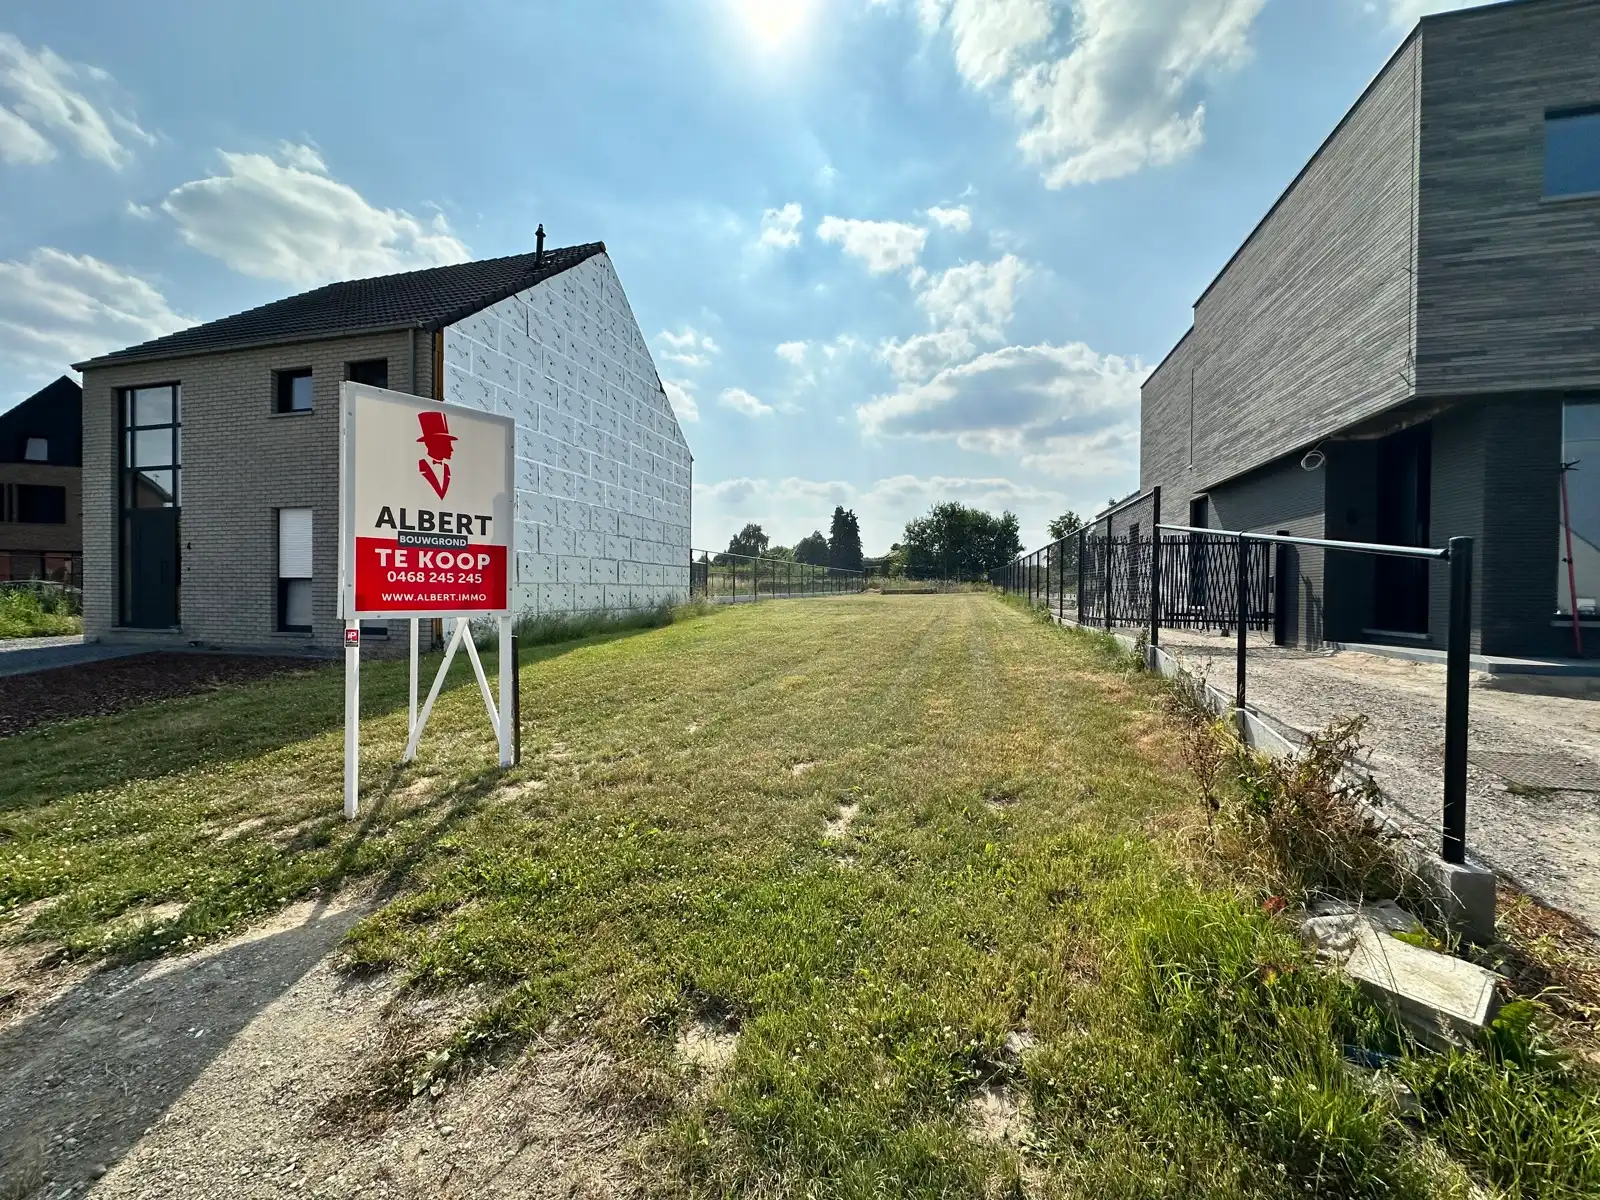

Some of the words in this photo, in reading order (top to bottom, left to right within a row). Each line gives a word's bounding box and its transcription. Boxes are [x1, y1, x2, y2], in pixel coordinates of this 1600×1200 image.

[375, 506, 492, 536] ALBERT
[400, 535, 467, 547] BOUWGROND
[375, 548, 408, 567] TE
[418, 551, 490, 570] KOOP
[387, 571, 425, 582] 0468
[429, 572, 454, 583] 245
[458, 573, 482, 583] 245
[381, 593, 487, 602] WWW.ALBERT.IMMO
